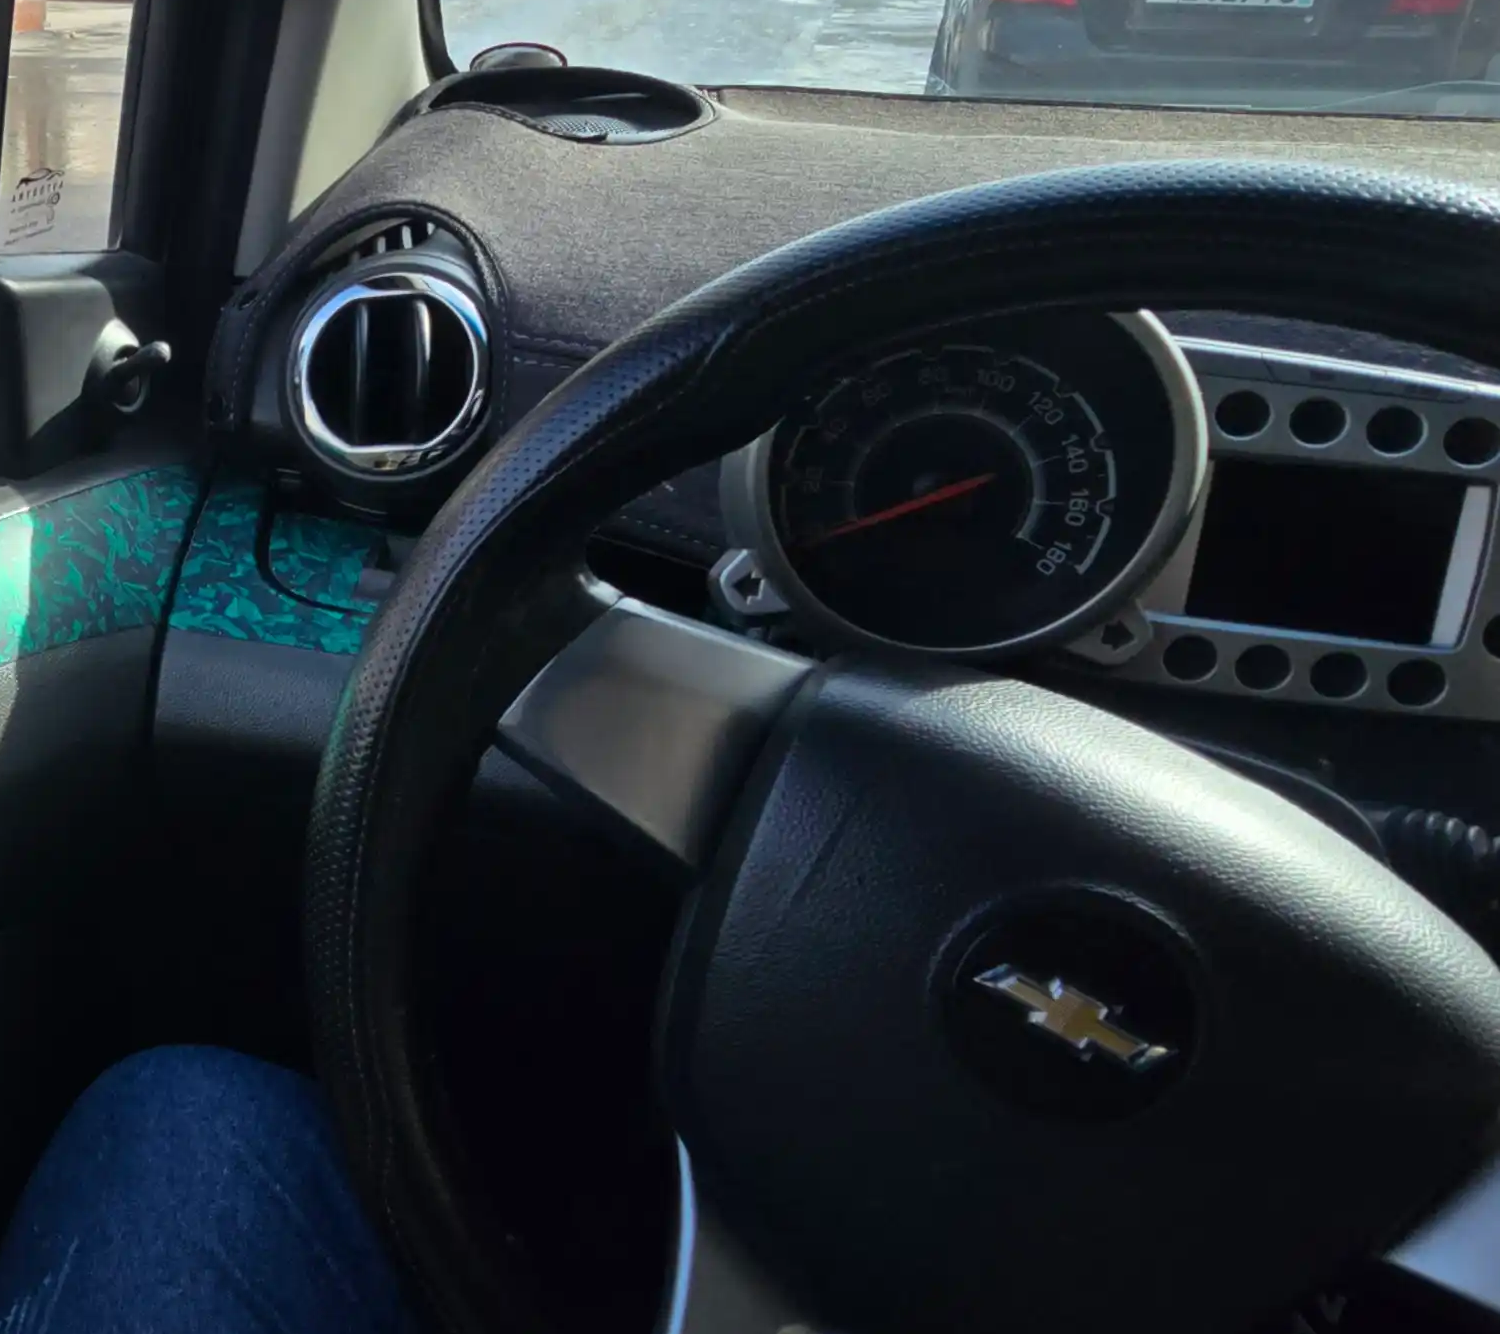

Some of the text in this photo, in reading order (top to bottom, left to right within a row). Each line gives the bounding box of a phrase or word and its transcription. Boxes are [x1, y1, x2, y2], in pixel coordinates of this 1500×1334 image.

[976, 368, 1016, 393] 100
[1027, 390, 1065, 426] 120
[1061, 433, 1089, 474] 140
[1064, 487, 1090, 527] 160
[1035, 540, 1073, 576] 180
